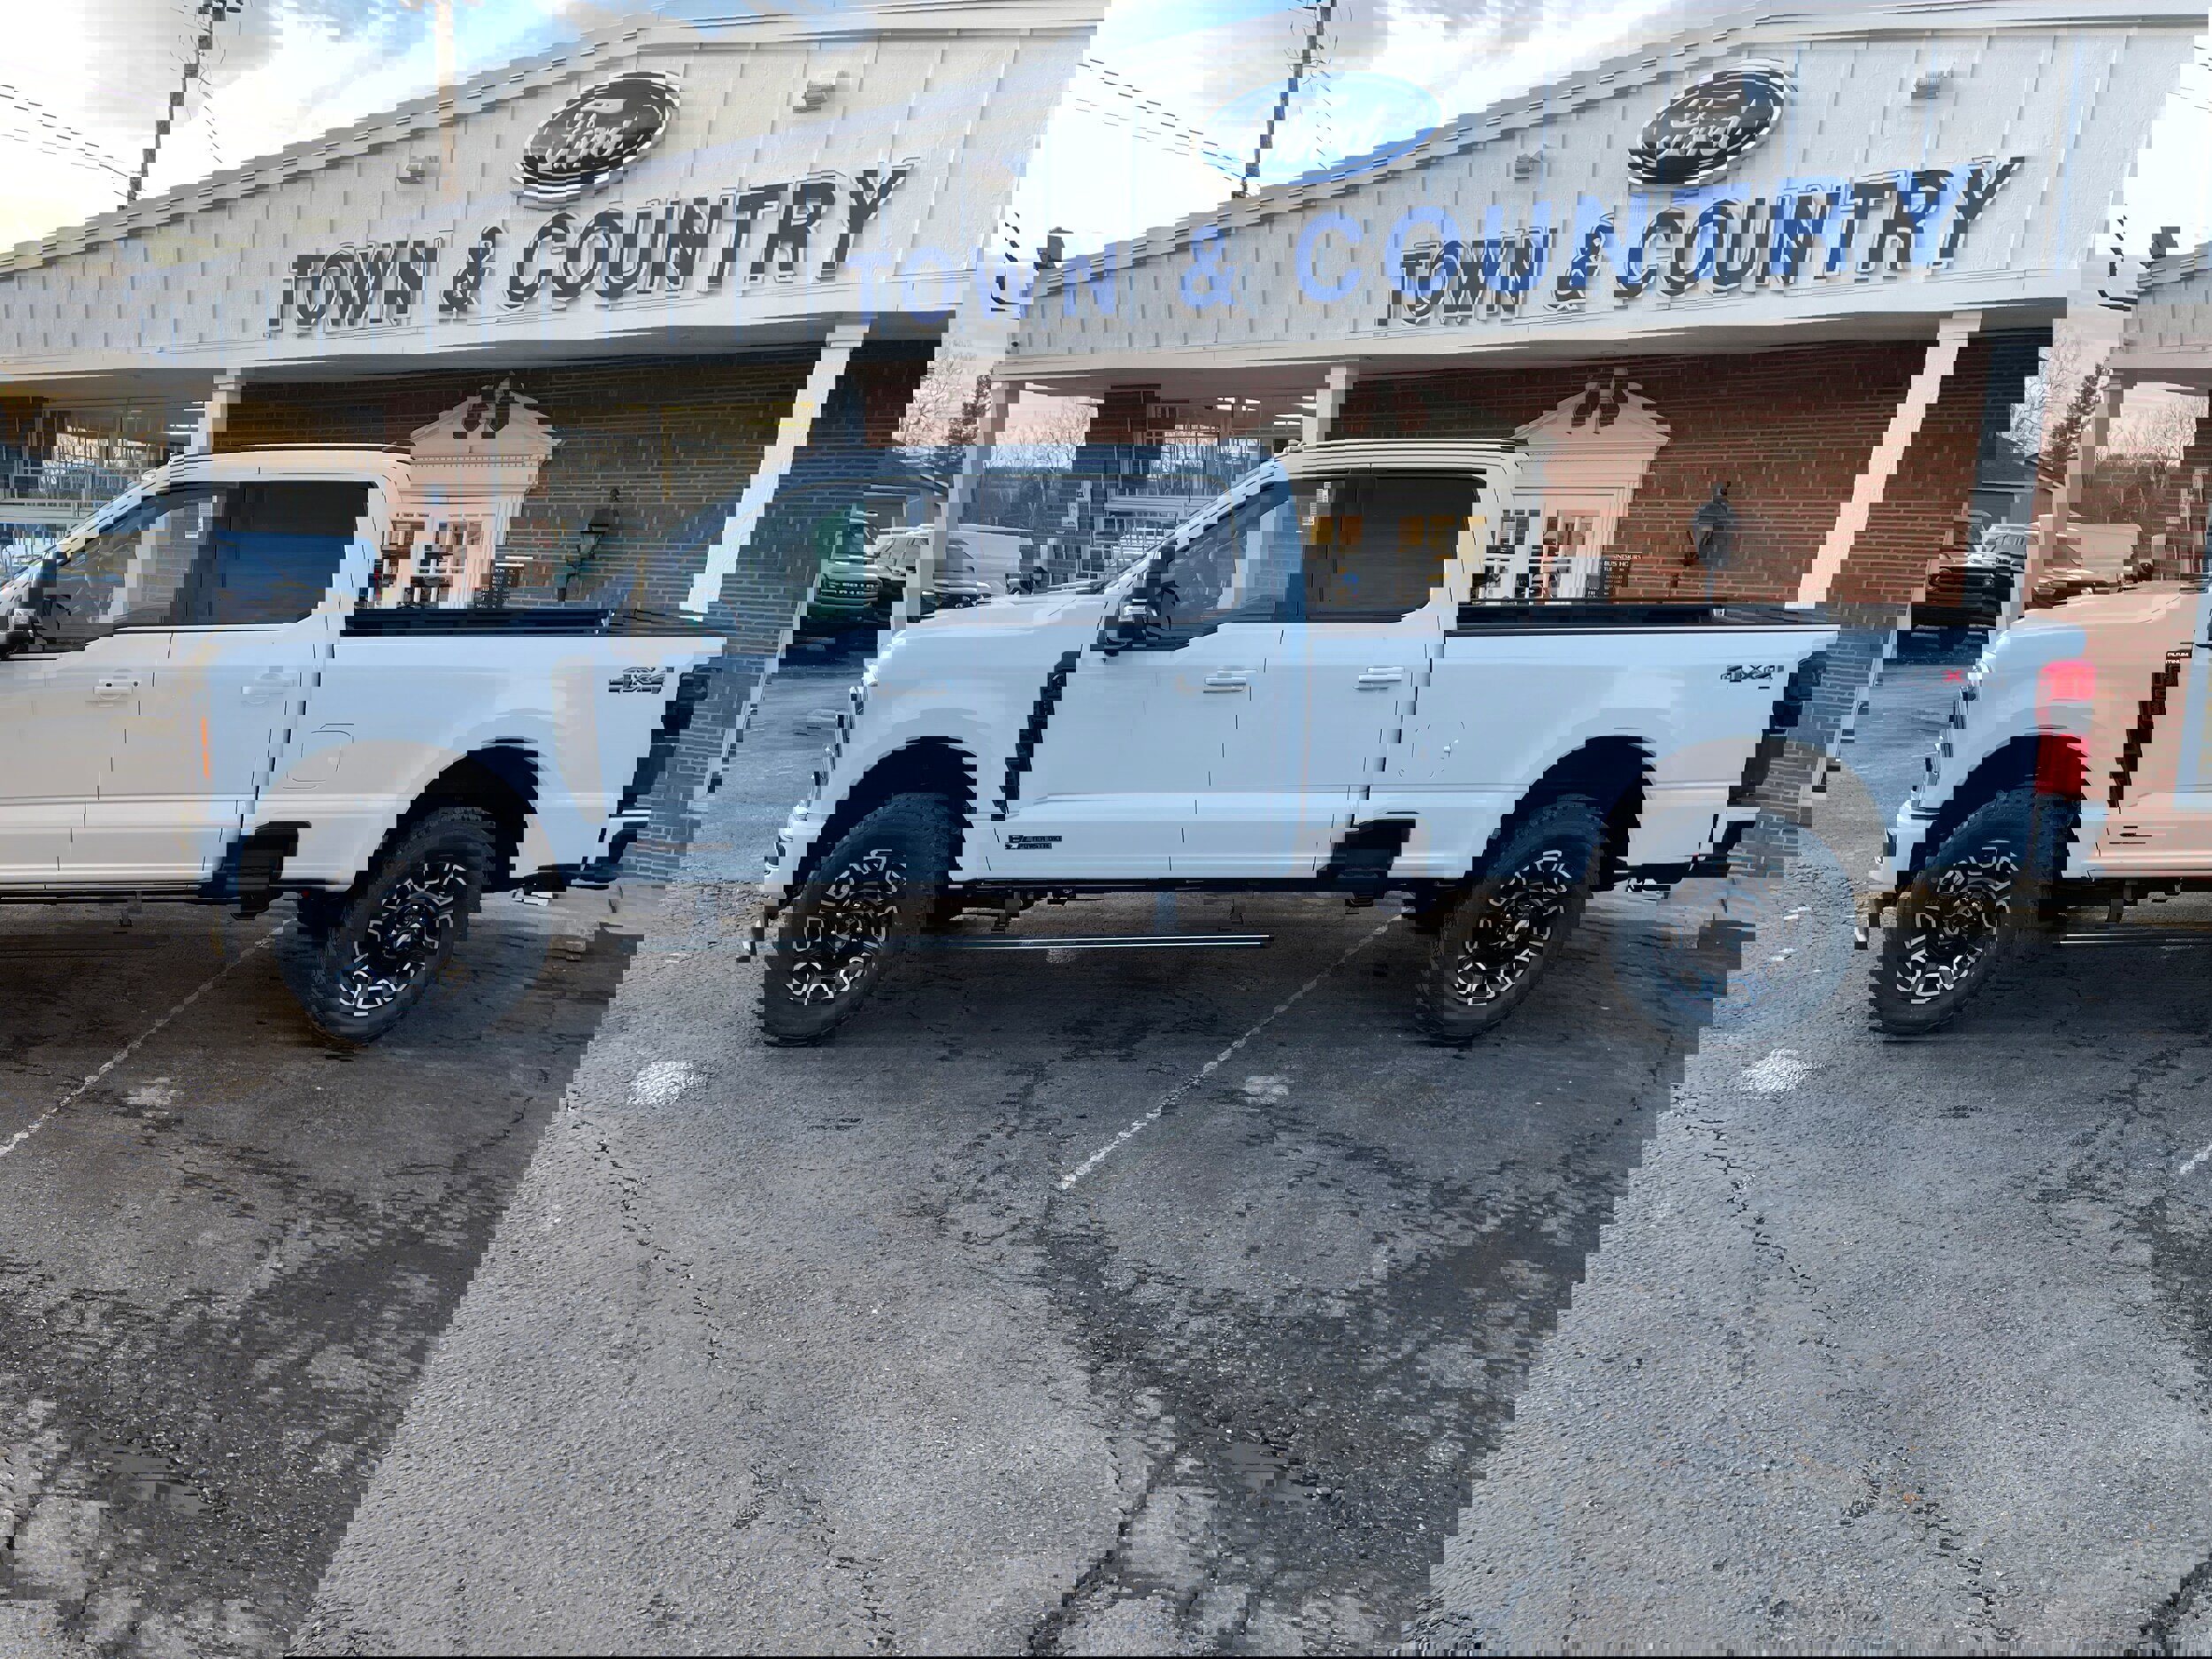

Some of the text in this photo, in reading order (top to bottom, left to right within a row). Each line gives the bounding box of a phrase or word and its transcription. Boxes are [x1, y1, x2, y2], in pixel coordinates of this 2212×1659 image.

[842, 157, 1987, 329] TOWN & COUNTRY
